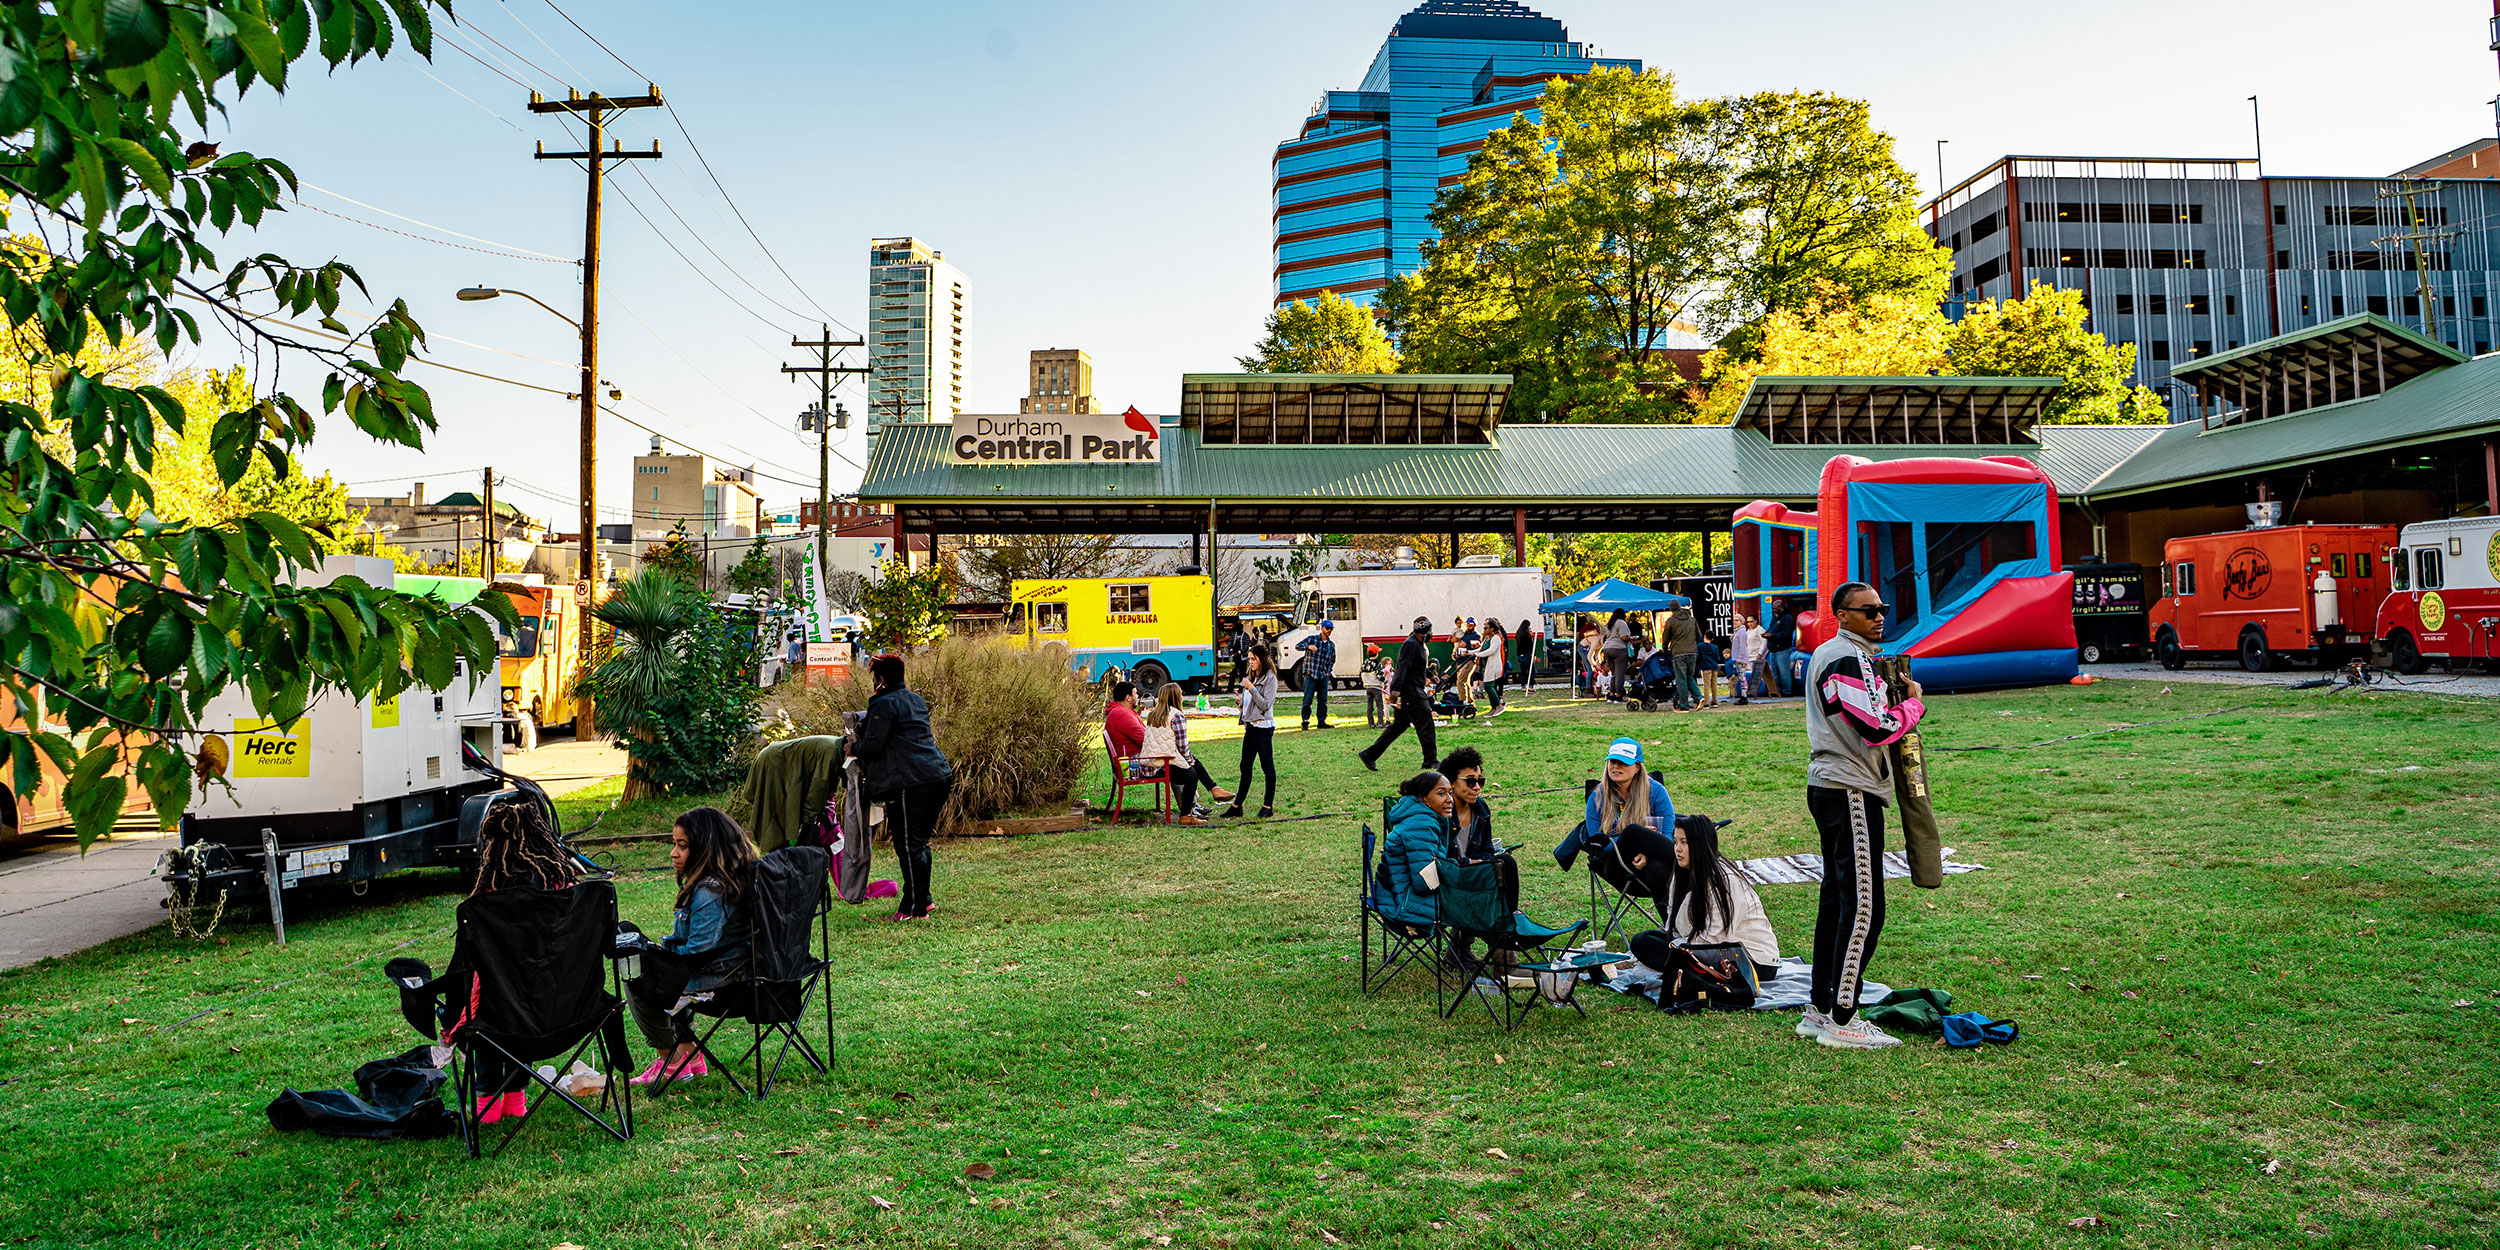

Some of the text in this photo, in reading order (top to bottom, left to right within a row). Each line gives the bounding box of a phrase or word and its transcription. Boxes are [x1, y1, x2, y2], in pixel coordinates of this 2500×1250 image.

[977, 418, 1062, 436] Durham
[955, 435, 1155, 460] Central Park
[1043, 585, 1068, 598] TACOS
[1713, 603, 1732, 617] FOR
[1106, 615, 1116, 624] LA
[1707, 617, 1732, 637] THE
[244, 738, 298, 756] Herc
[258, 757, 293, 765] Rentals
